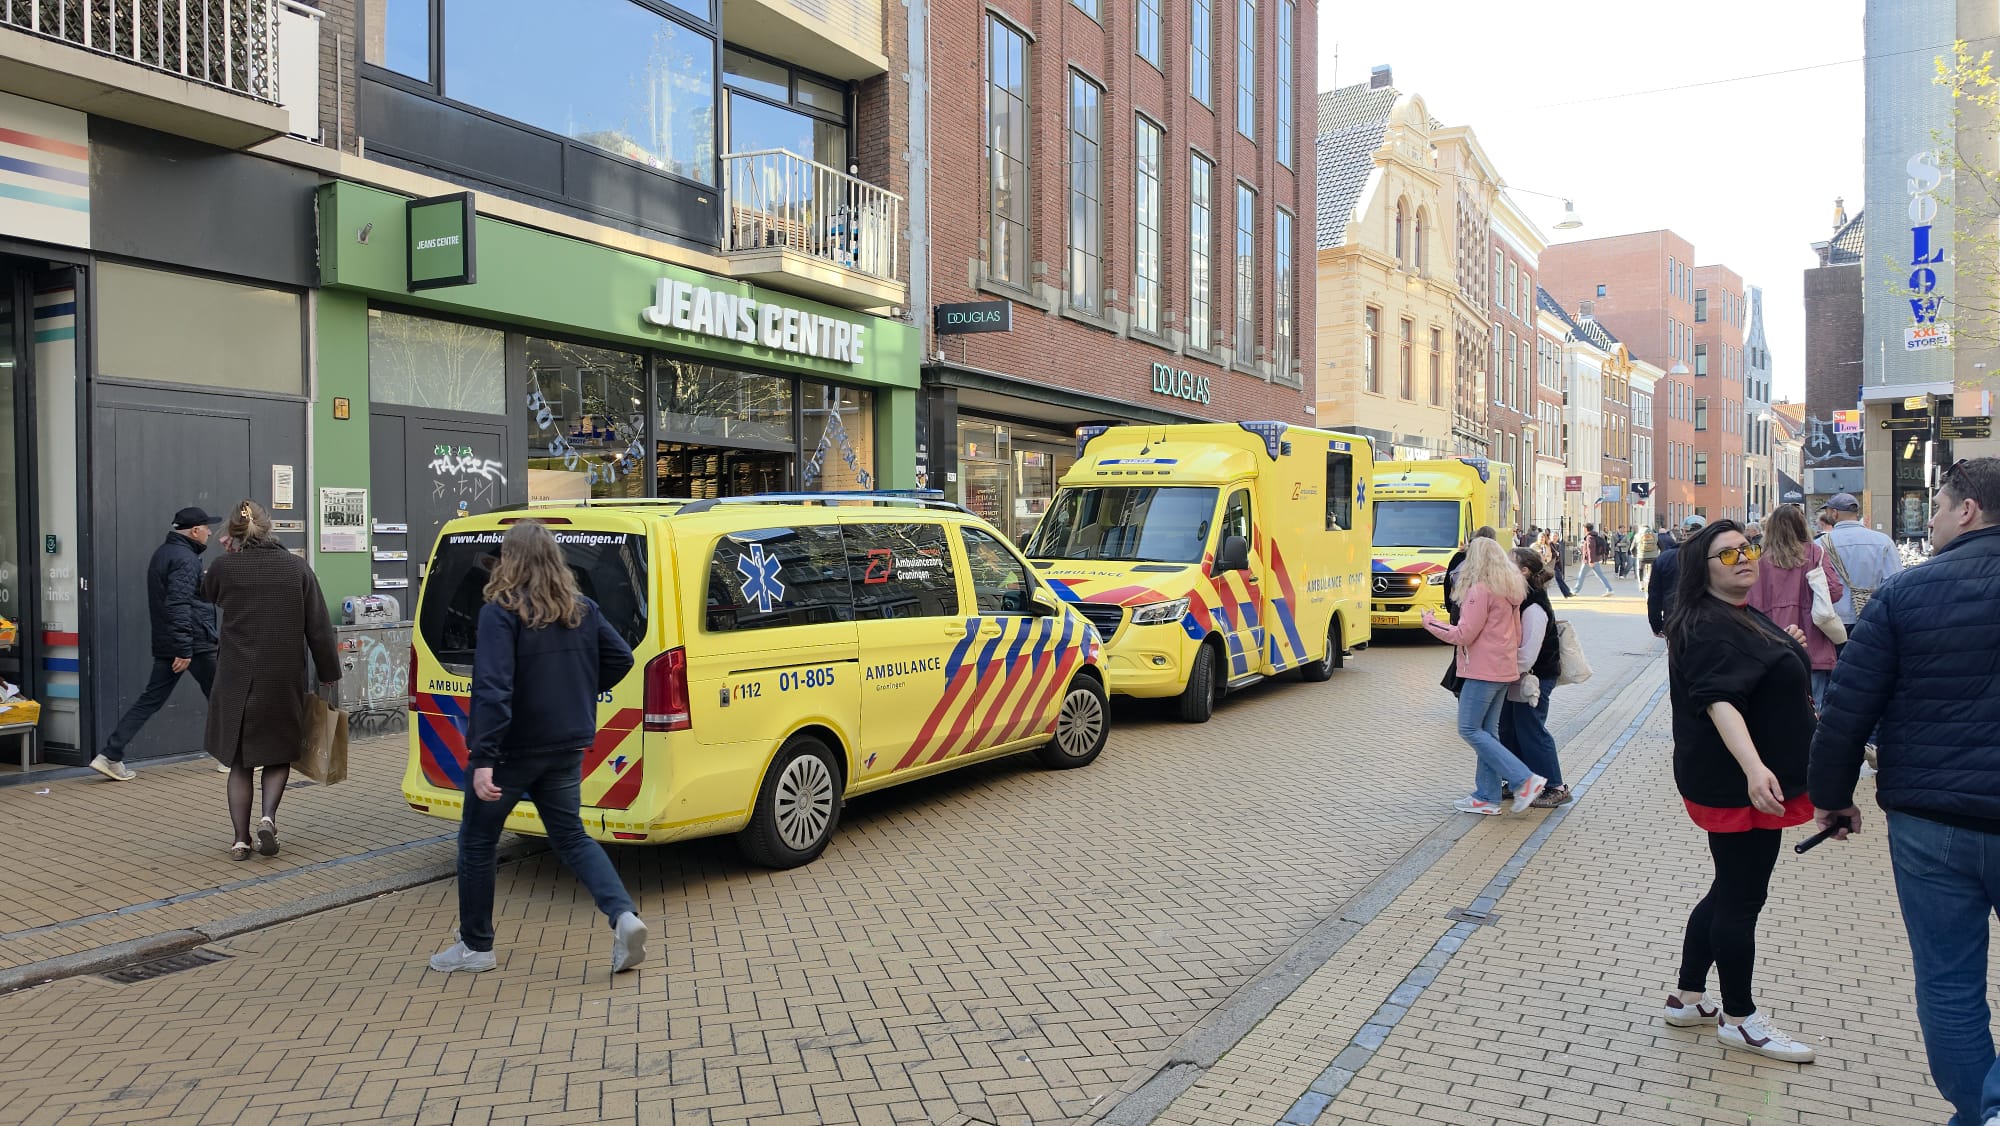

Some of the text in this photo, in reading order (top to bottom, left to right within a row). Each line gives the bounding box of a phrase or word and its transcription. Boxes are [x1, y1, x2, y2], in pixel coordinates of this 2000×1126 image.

[416, 235, 459, 250] JEANS CENTRE
[642, 278, 865, 364] JEANS CENTRE
[947, 310, 1001, 324] DOUGLAS
[1913, 328, 1939, 338] XXL
[1152, 362, 1210, 404] DOUGLAS
[1841, 424, 1857, 432] Low
[896, 557, 943, 569] Ambulancezorg
[49, 565, 70, 578] and
[897, 571, 930, 580] Groningen
[1306, 576, 1342, 593] AMBULANCE
[865, 656, 941, 681] AMBULANCE
[429, 679, 472, 693] AMBULA
[779, 667, 835, 692] 01-805
[875, 681, 906, 692] Groningen
